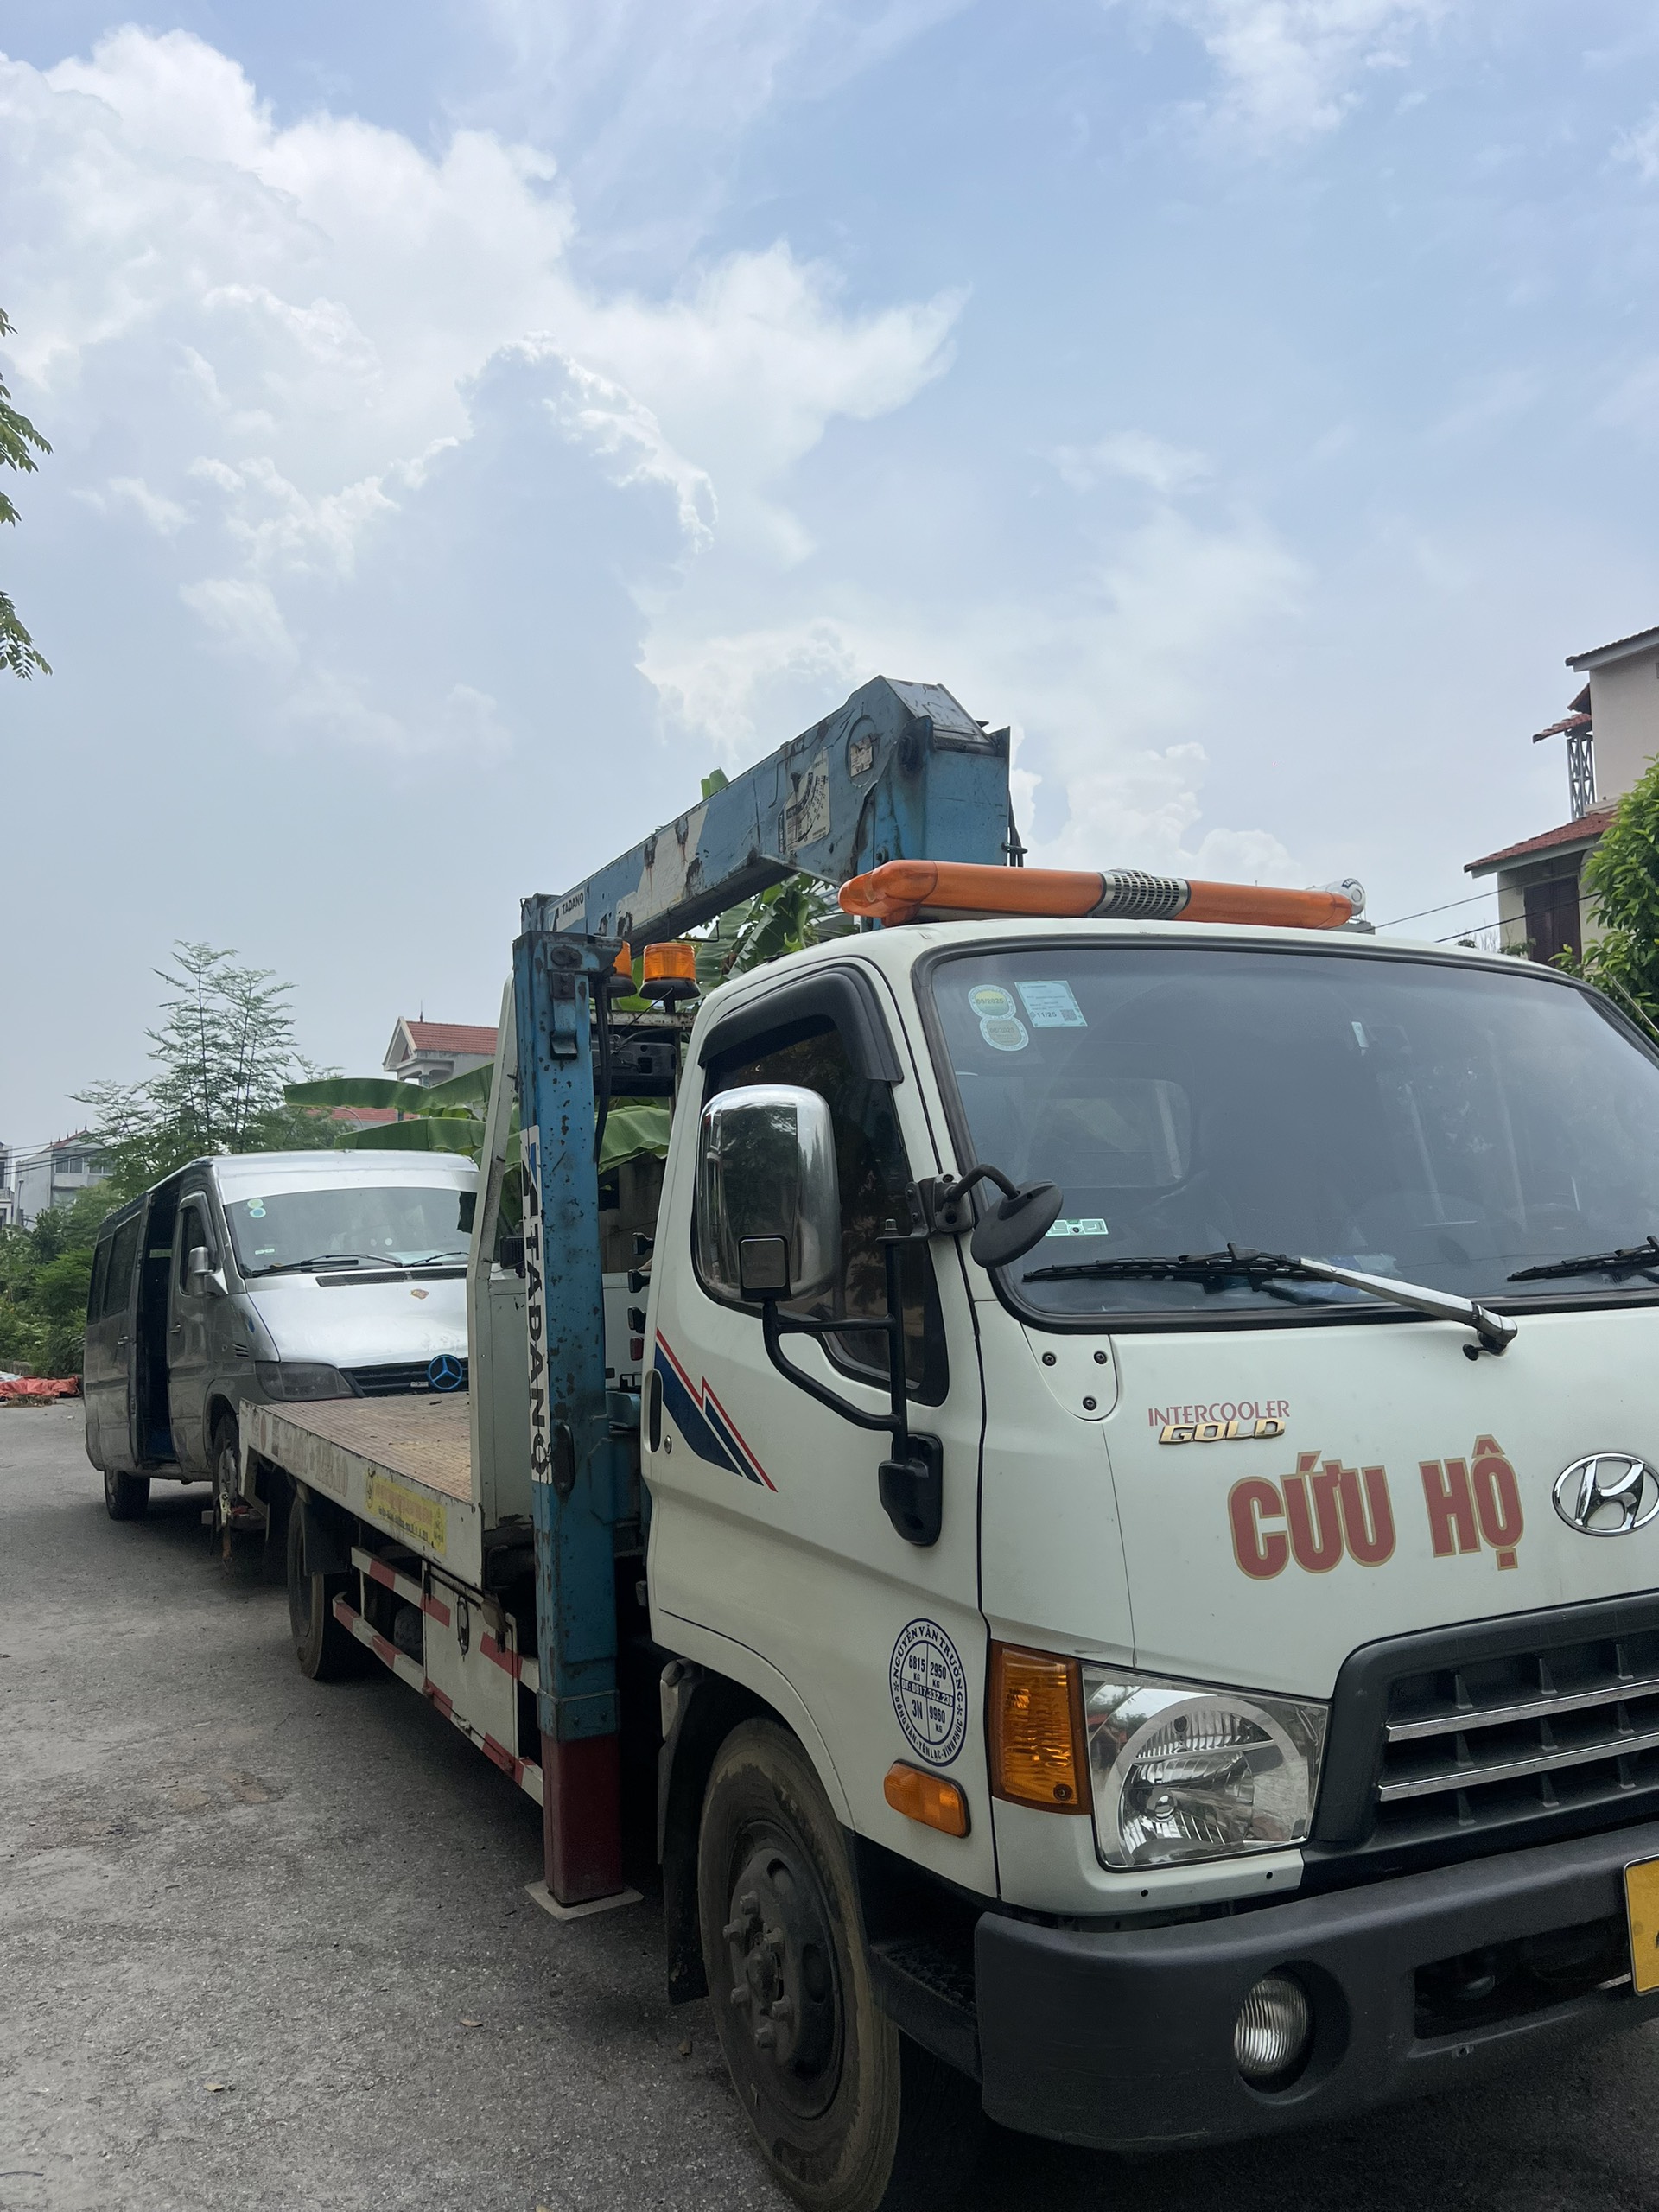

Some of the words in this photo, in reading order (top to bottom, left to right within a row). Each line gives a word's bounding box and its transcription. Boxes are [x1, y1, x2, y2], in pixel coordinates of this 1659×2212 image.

[561, 891, 585, 916] TADANO
[524, 1223, 552, 1475] TADANO
[1147, 1399, 1291, 1427] INTERCOOLER
[1158, 1418, 1287, 1446] GOLD
[1227, 1450, 1396, 1581] CỨU
[1418, 1433, 1525, 1572] HỘ
[919, 1624, 939, 1643] VĂN
[908, 1654, 925, 1673] 6815
[930, 1662, 947, 1681] 2950
[913, 1672, 921, 1682] KG
[932, 1679, 940, 1689] KG
[912, 1699, 924, 1720] 3N
[929, 1705, 946, 1725] 9960
[935, 1723, 943, 1733] KG
